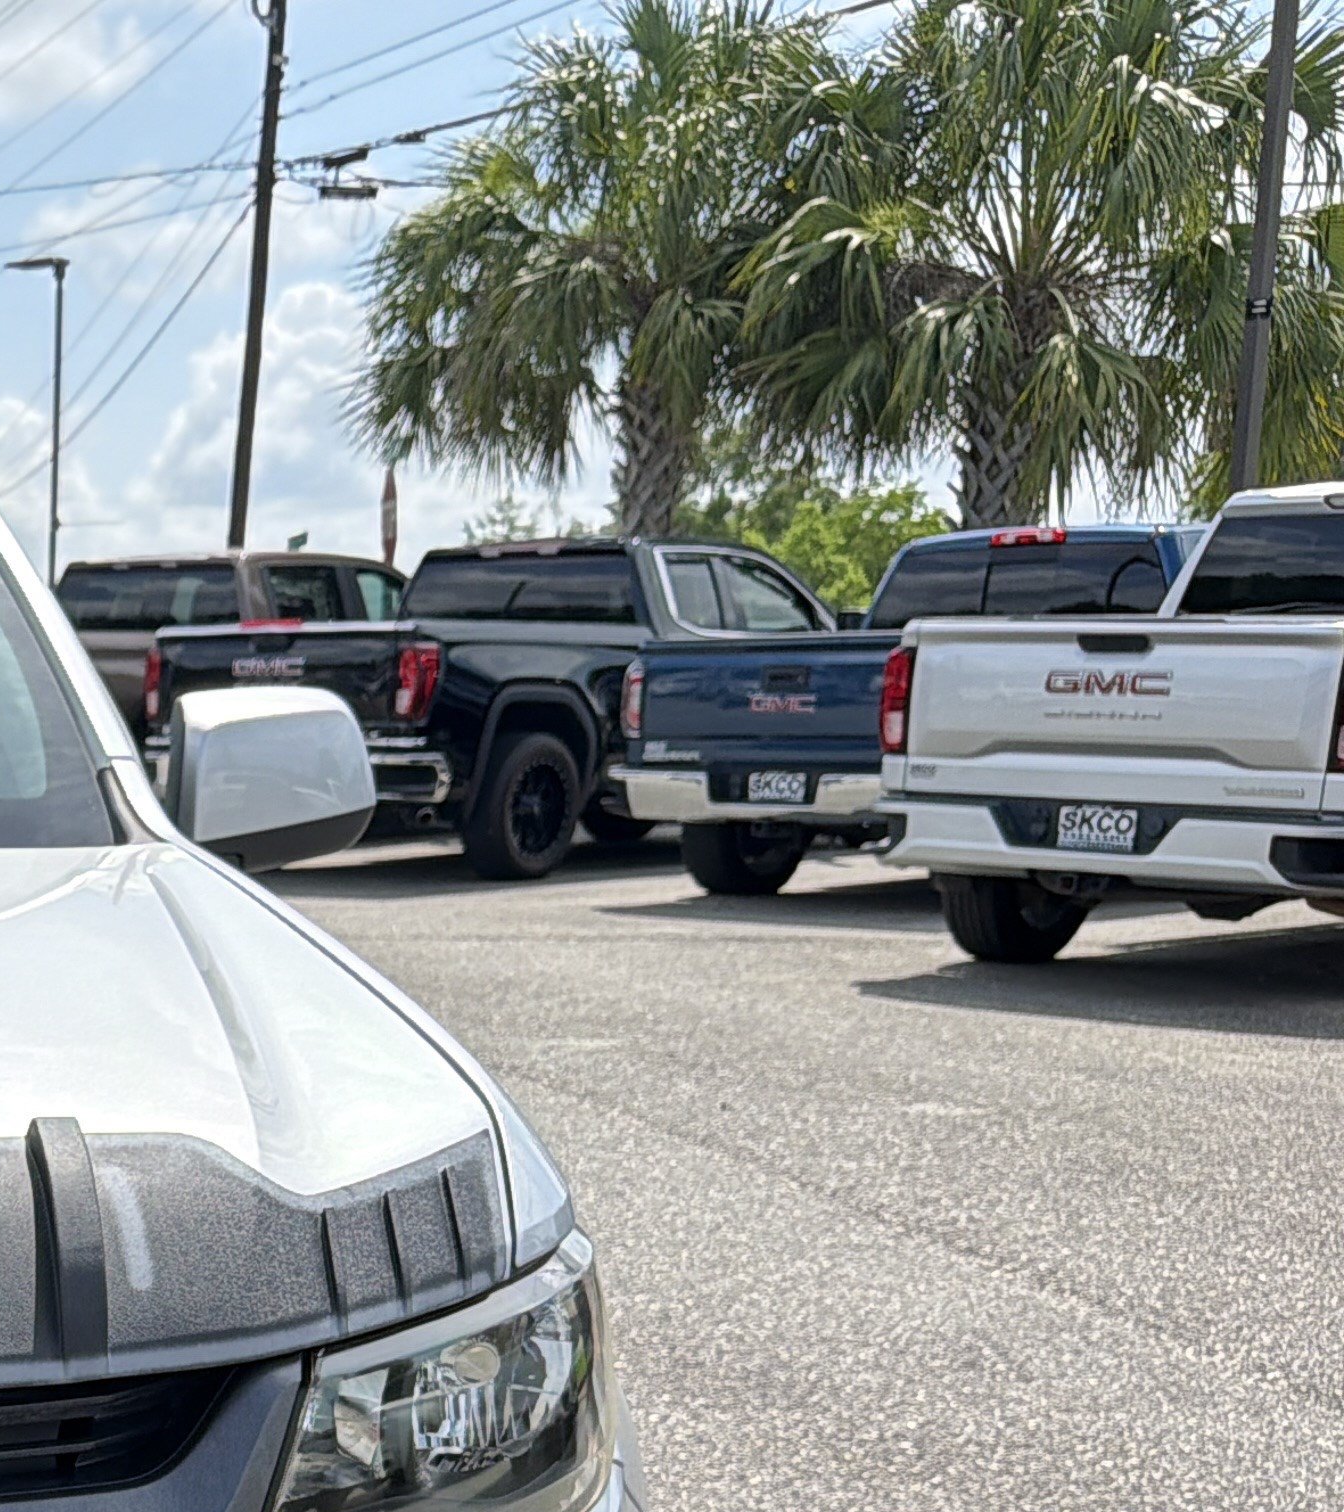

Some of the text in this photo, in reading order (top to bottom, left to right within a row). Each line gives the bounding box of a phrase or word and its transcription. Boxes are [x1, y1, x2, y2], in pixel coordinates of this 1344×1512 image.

[231, 656, 305, 677] GMC
[1045, 670, 1173, 697] GMC
[748, 693, 816, 713] GMC
[750, 778, 802, 794] SKCO
[1061, 809, 1134, 835] SKCO
